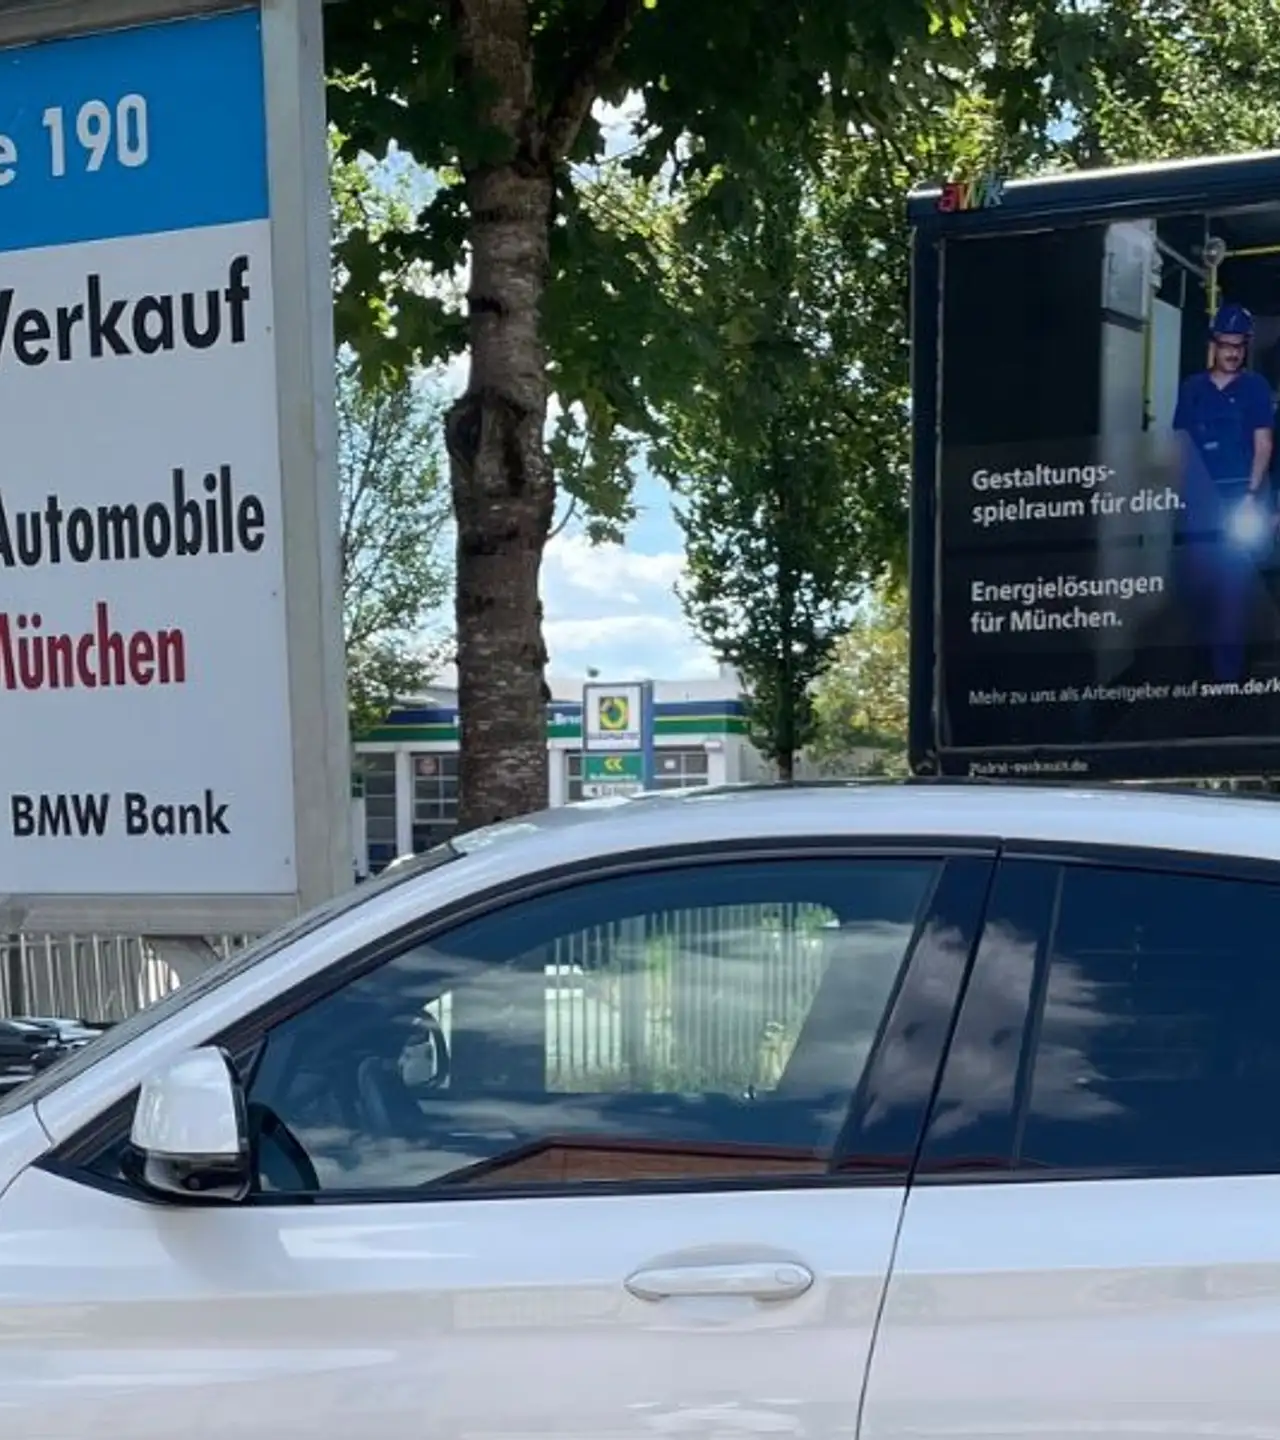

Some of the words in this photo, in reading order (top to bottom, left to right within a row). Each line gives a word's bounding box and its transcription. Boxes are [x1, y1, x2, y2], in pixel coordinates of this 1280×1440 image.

[43, 92, 150, 177] 190
[972, 463, 1116, 491] Gestaltungs-
[972, 498, 1084, 527] spielraum
[1090, 492, 1124, 515] für
[1129, 487, 1187, 512] dich.
[971, 575, 1164, 604] Energielösungen
[970, 611, 1004, 634] für
[1010, 606, 1122, 632] München.
[969, 689, 1008, 705] Mehr
[1172, 680, 1198, 697] auf
[12, 794, 110, 838] BMW
[124, 790, 231, 836] Bank
